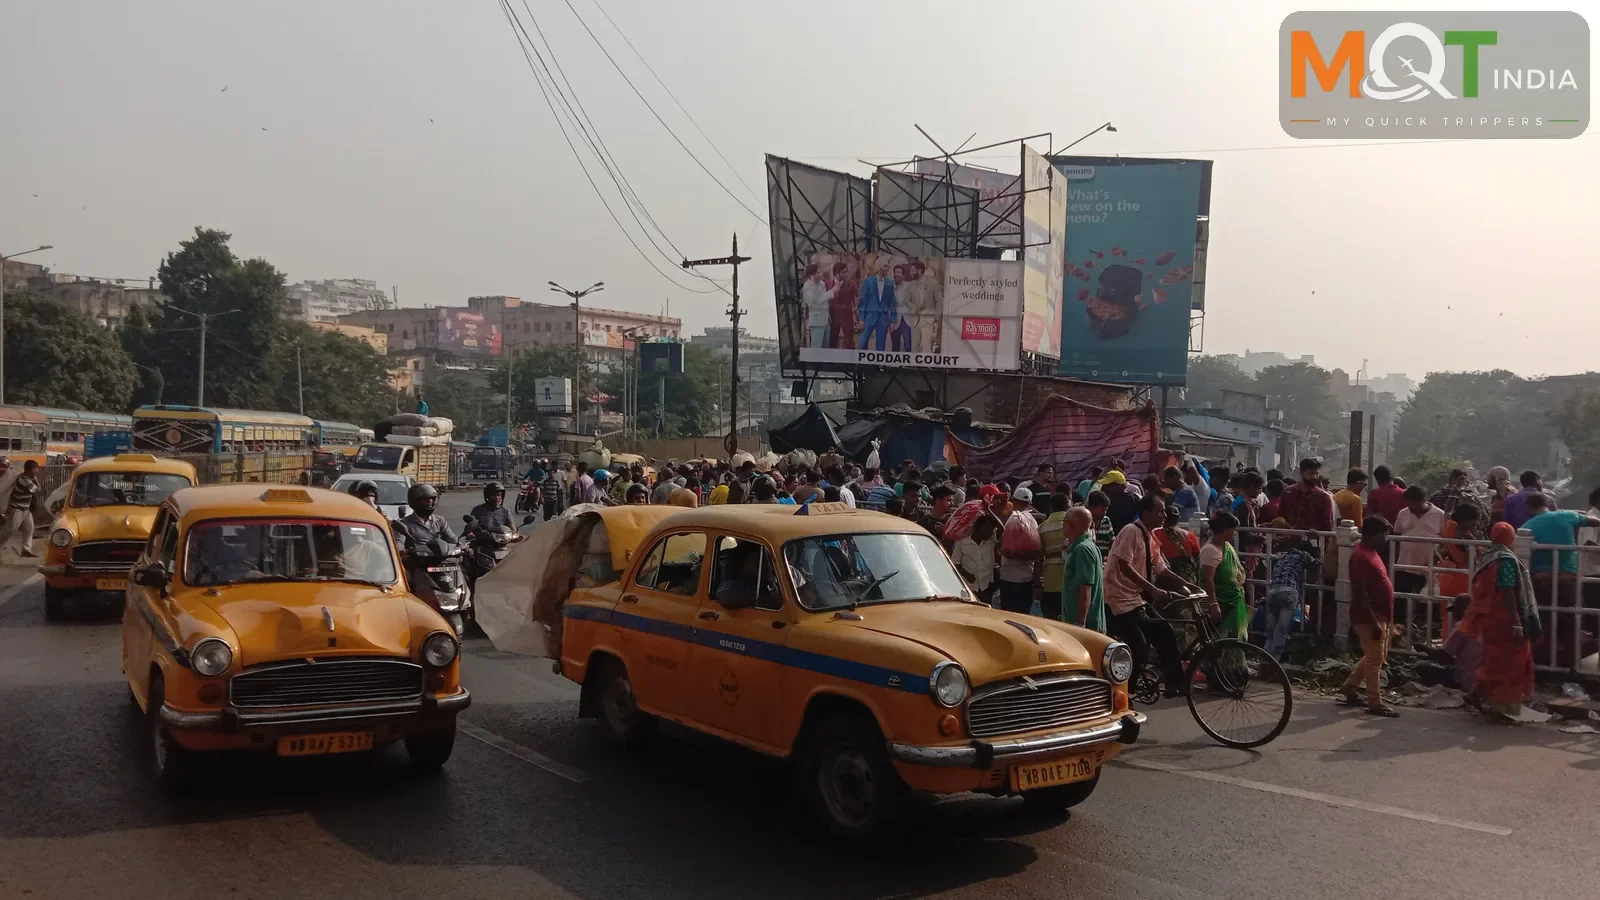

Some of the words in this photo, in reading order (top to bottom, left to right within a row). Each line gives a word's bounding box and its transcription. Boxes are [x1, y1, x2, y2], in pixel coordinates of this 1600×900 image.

[1065, 168, 1093, 176] PHILIPS
[1067, 203, 1092, 212] ew
[1095, 203, 1113, 212] on
[1116, 200, 1140, 212] the
[948, 276, 987, 288] Perfectly
[990, 278, 1018, 289] styled
[961, 291, 1005, 301] weddings
[858, 352, 911, 364] PODDAR
[914, 354, 960, 366] COURT
[811, 503, 846, 514] TAXI
